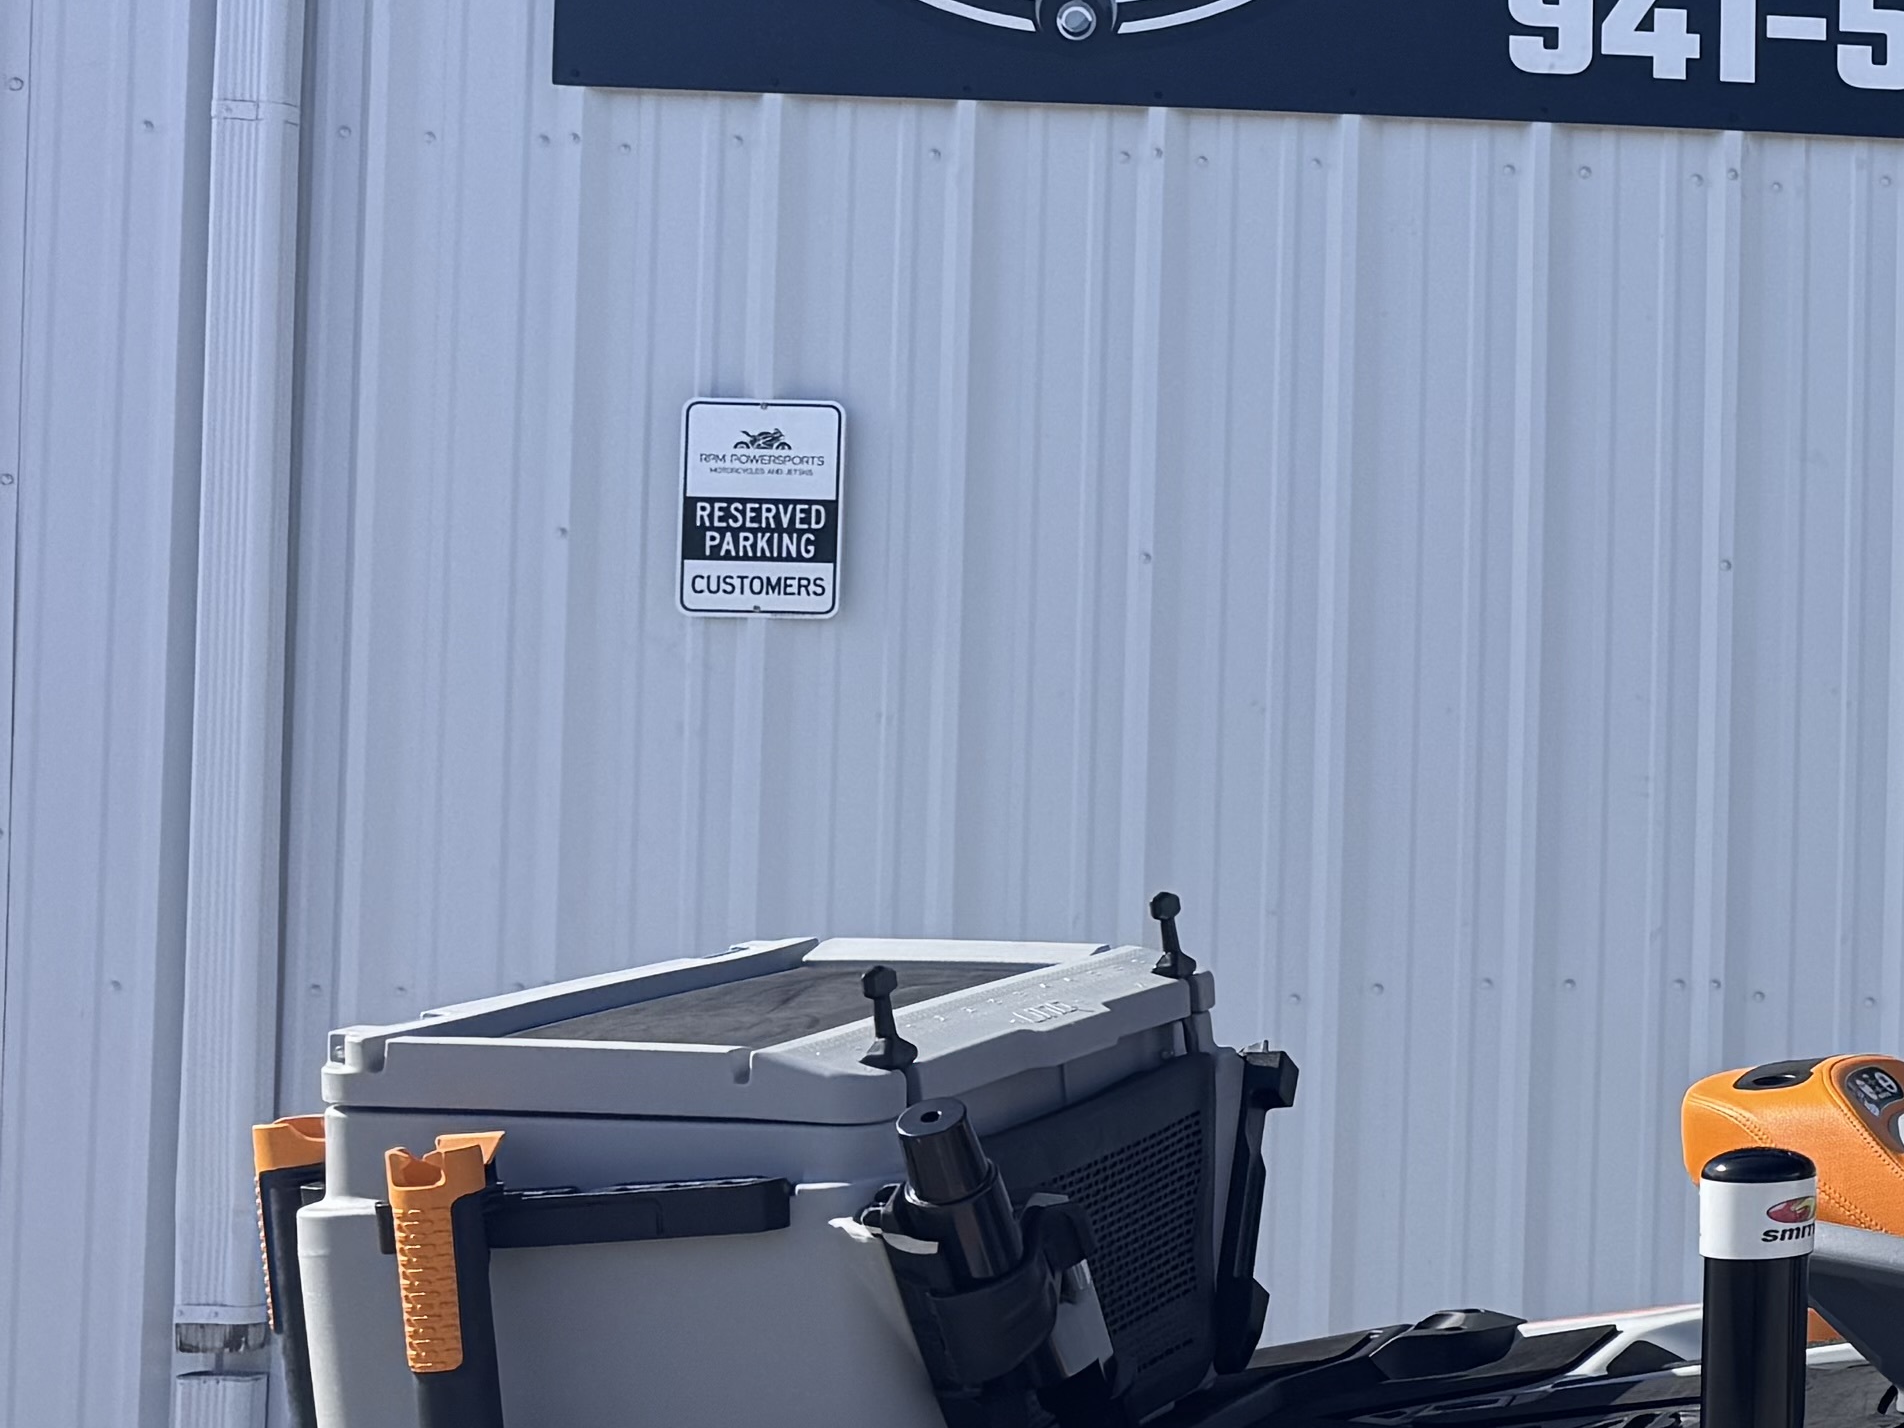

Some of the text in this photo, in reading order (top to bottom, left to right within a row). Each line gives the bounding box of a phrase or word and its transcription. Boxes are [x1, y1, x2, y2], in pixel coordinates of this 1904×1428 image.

[731, 454, 824, 467] POWERSPORTS
[695, 501, 826, 529] RESERVED
[704, 530, 816, 558] PARKING
[691, 575, 826, 596] CUSTOMERS
